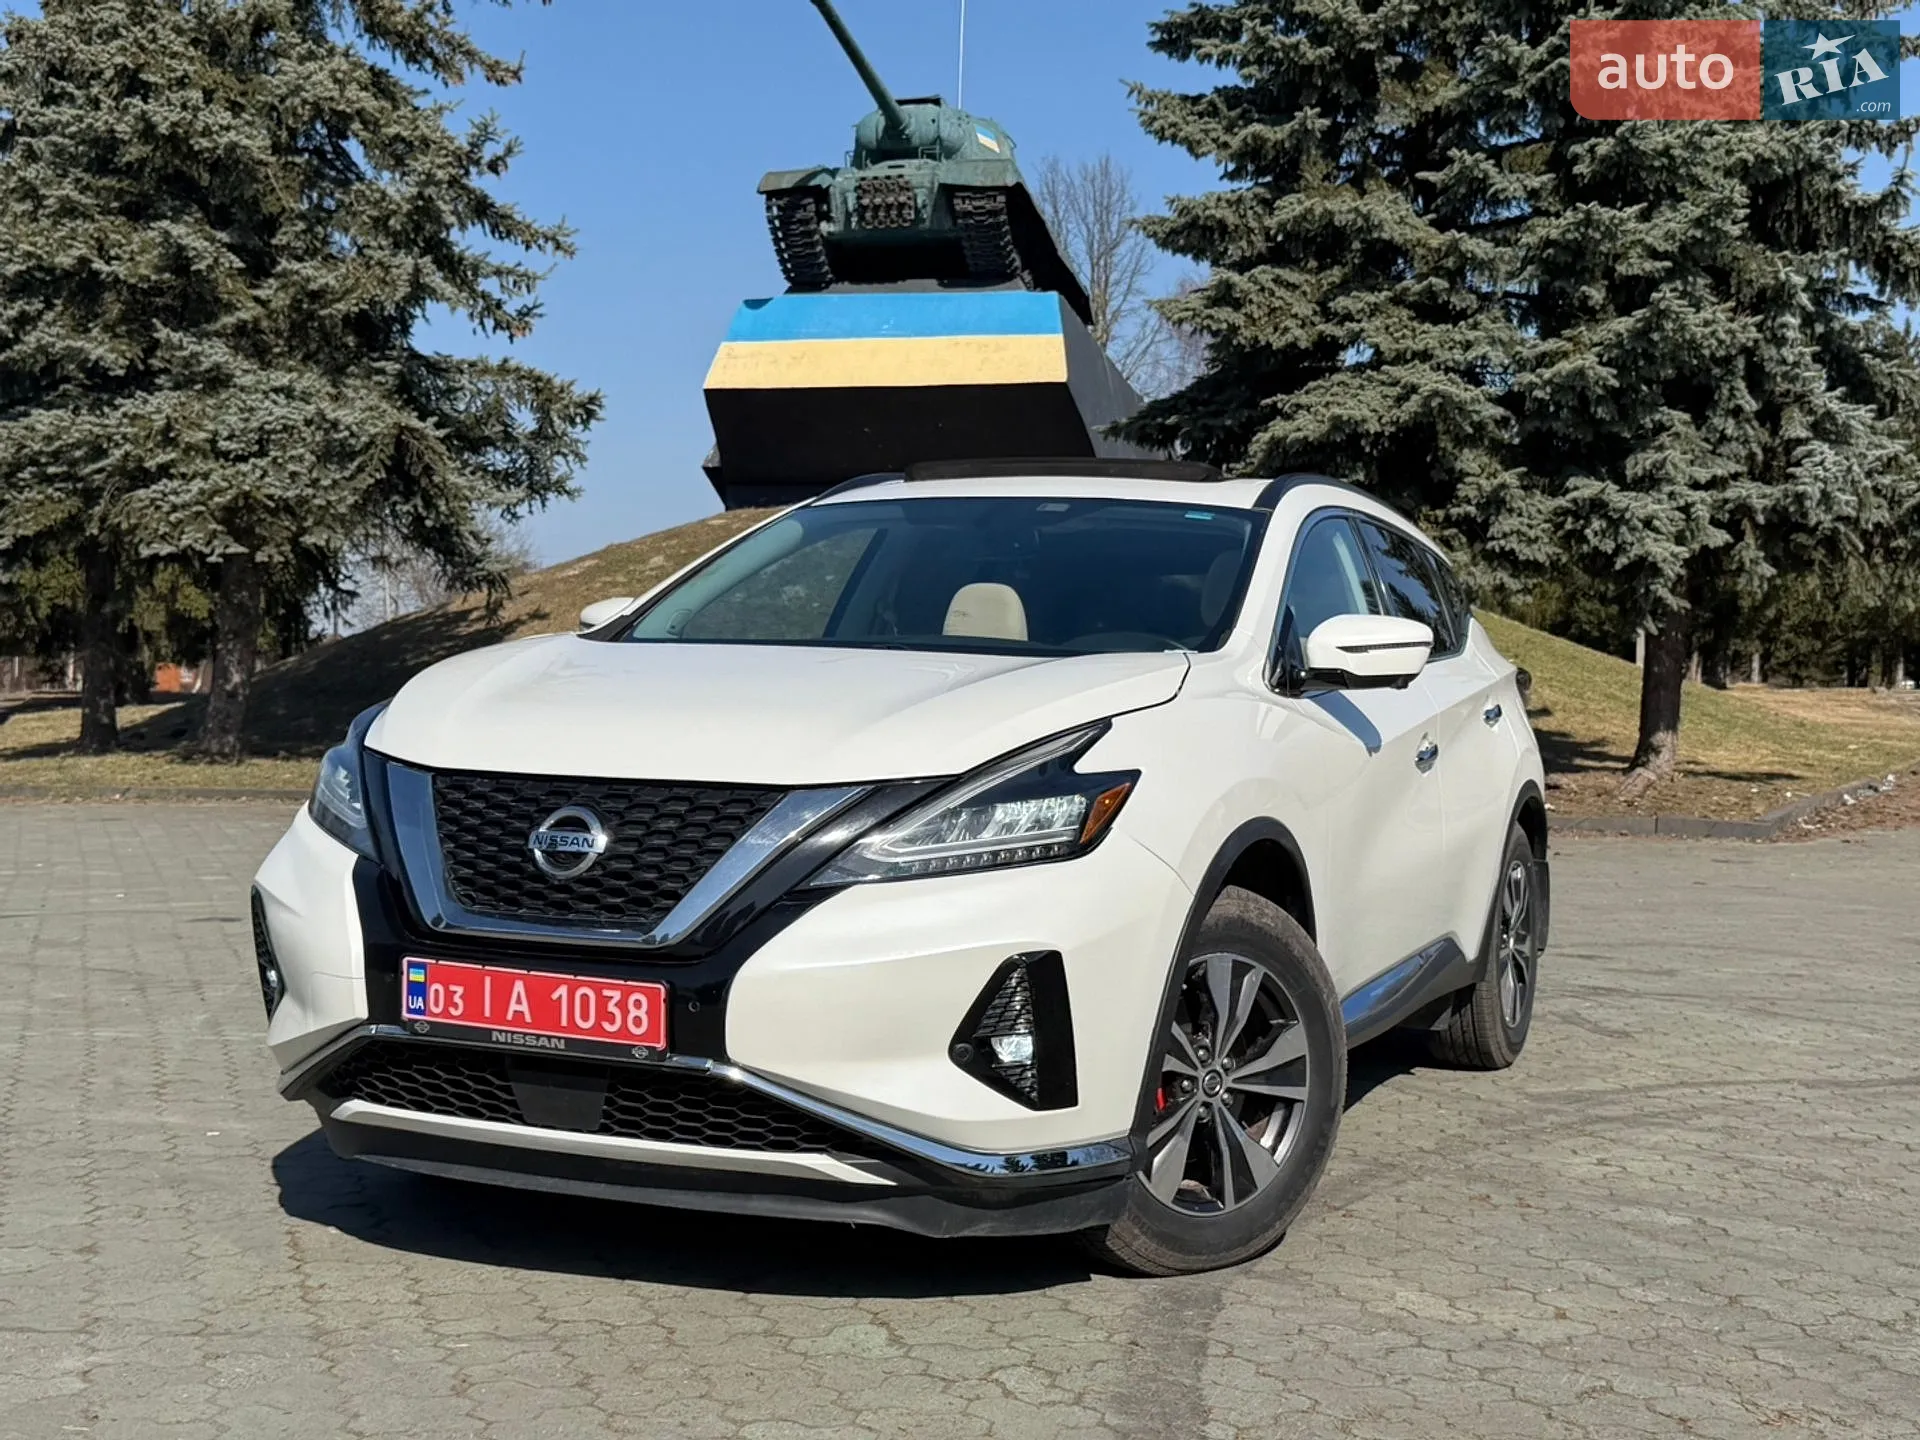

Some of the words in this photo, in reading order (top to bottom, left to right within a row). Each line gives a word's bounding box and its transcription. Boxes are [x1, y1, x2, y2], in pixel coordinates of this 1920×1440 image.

[532, 833, 596, 849] NISSAN
[408, 994, 425, 1011] UA
[428, 982, 465, 1017] 03
[550, 983, 650, 1036] 1038
[490, 1030, 566, 1050] NISSAN
